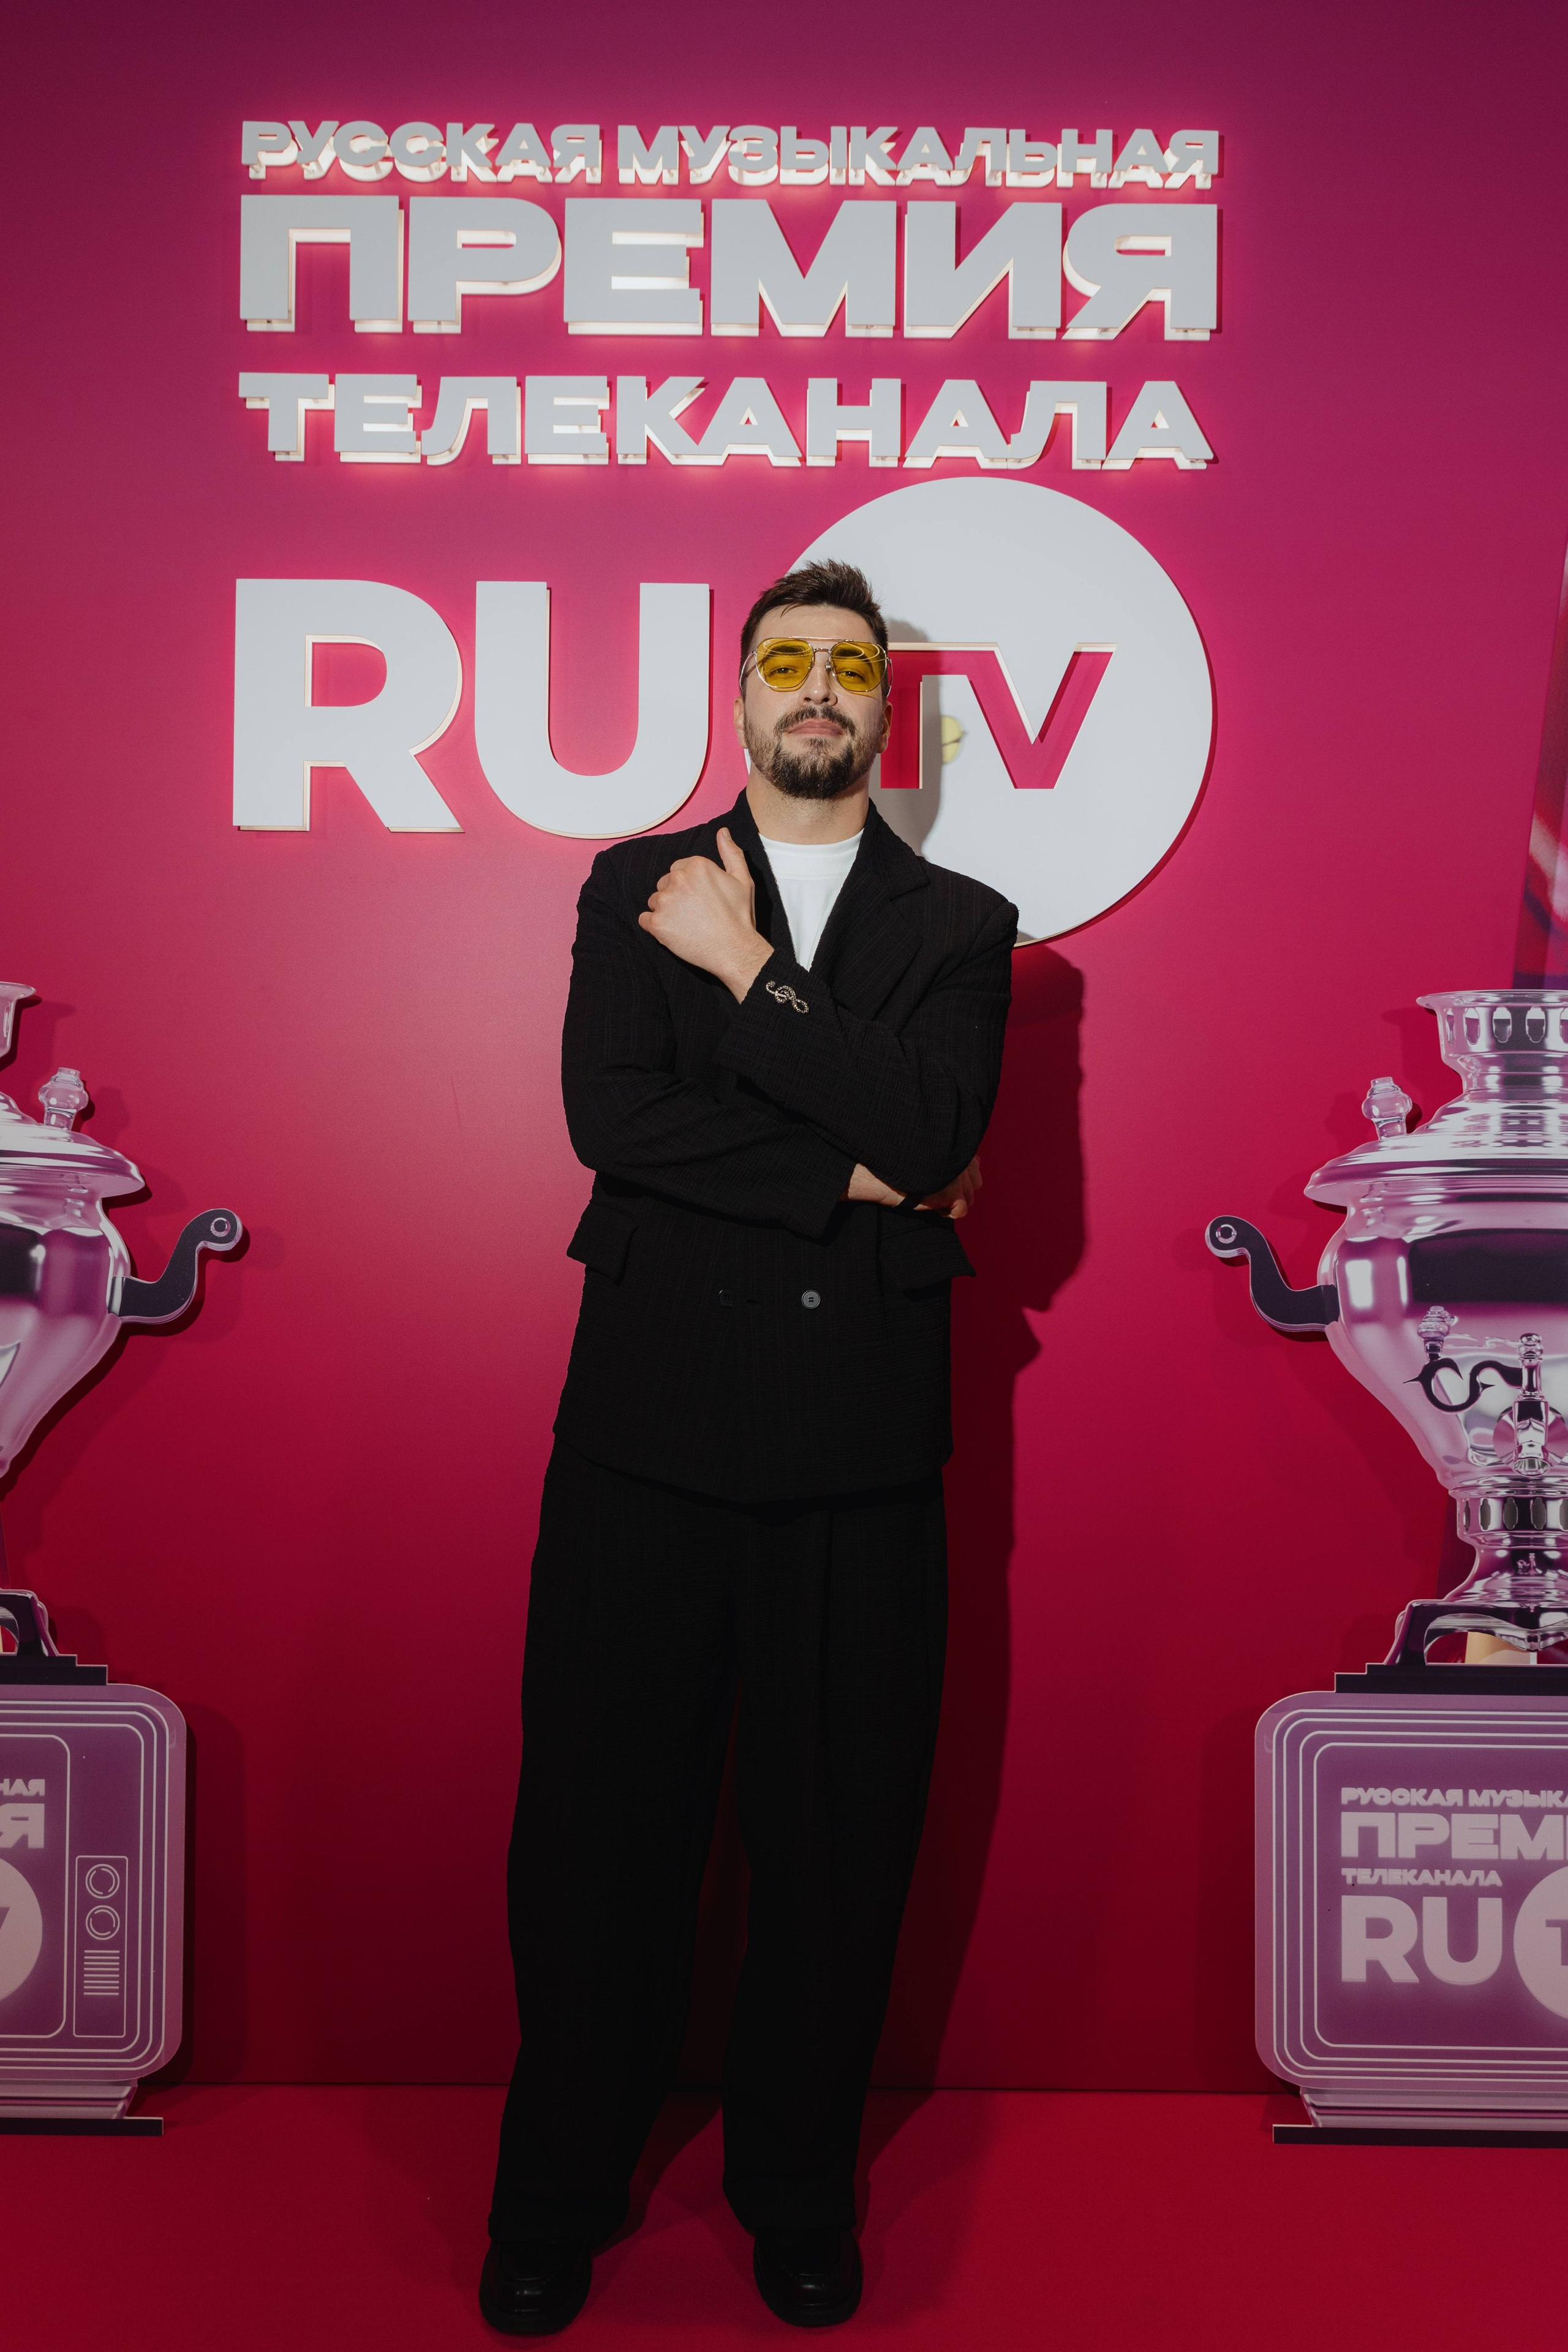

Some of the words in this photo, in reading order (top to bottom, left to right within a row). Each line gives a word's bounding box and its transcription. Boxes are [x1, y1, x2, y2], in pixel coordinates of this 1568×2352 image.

[241, 121, 602, 185] РУССКАЯ
[617, 124, 1219, 189] МУЗЫКАЛЬНАЯ
[240, 194, 1218, 341] ПРЕМИЯ
[239, 372, 1215, 470] ТЕЛЕКАНАЛА
[233, 578, 710, 839] RU
[1341, 1811, 1568, 1861] ПРЕМ
[1468, 1789, 1568, 1808] МУЗЫК
[1341, 1868, 1503, 1887] ТЕЛЕКАНАЛА
[1341, 1894, 1503, 1986] RU
